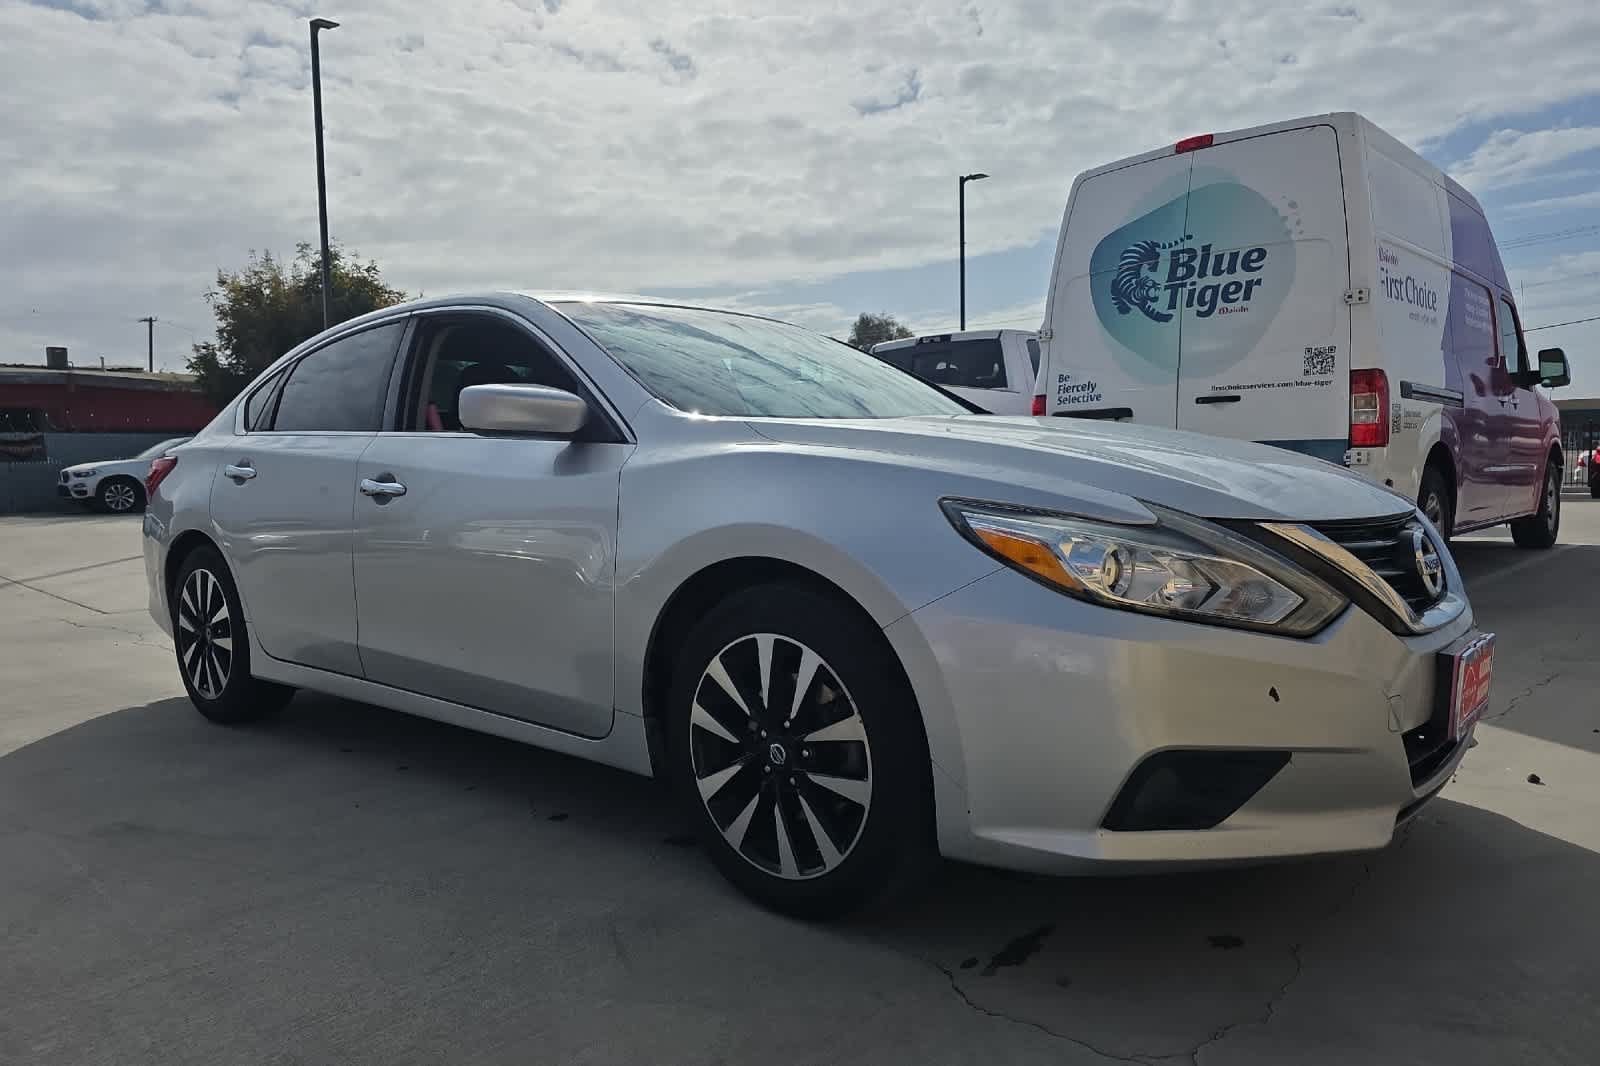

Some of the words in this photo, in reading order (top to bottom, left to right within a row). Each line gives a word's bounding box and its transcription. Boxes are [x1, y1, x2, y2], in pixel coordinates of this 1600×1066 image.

[1166, 243, 1267, 283] Blue
[1164, 277, 1263, 318] Tiger
[1405, 275, 1438, 312] Choice
[1057, 380, 1097, 395] Fiercely
[1058, 373, 1070, 383] Be
[1056, 392, 1102, 406] Selective
